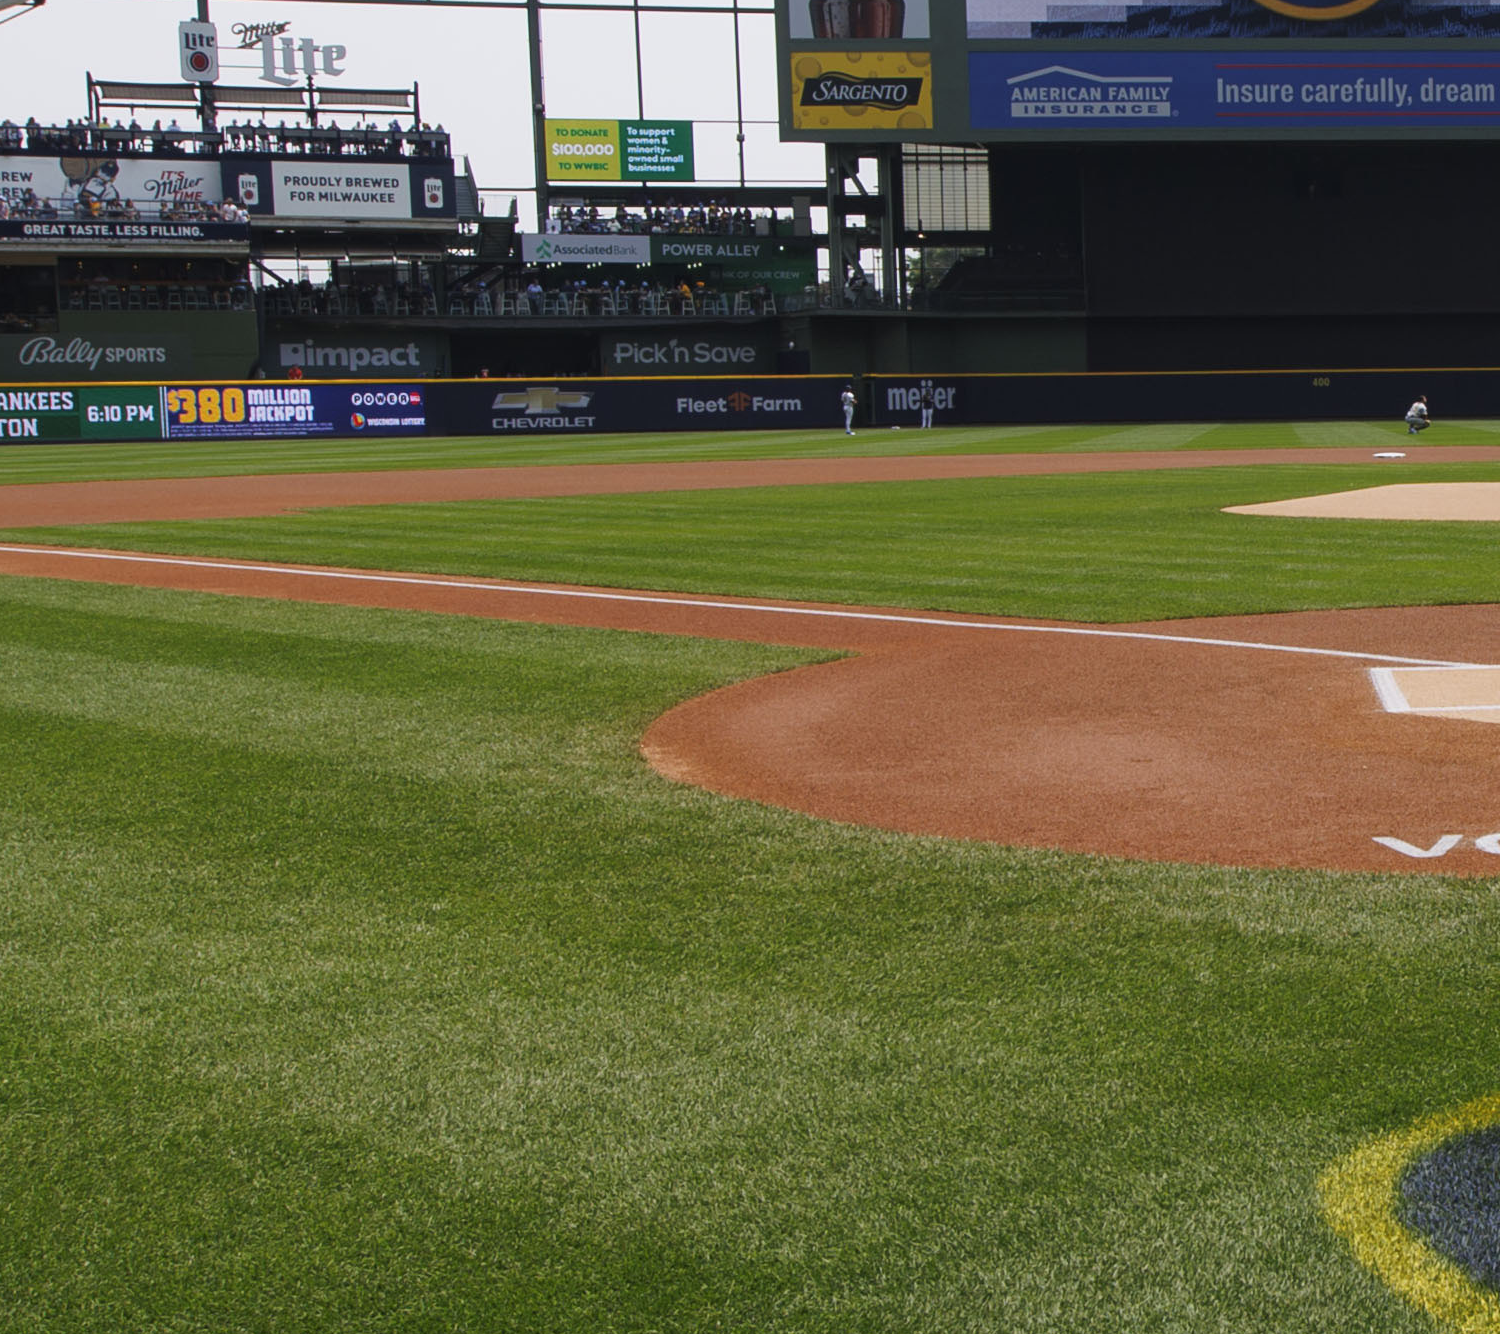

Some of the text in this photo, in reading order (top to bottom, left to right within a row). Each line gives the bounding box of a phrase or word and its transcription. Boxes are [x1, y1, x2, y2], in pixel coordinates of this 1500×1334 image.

[183, 32, 216, 50] Lite
[258, 35, 348, 87] Lite
[812, 80, 908, 102] SARGENTO
[1011, 86, 1171, 102] AMERICAN FAMILY
[1216, 78, 1294, 104] Insure
[1299, 77, 1414, 108] carefully,
[1419, 77, 1496, 104] dream
[1023, 104, 1159, 115] INSURANCE
[556, 127, 609, 138] TO DONATE
[552, 142, 615, 158] $100,000
[558, 161, 570, 172] TO
[160, 170, 185, 181] IT'S
[283, 175, 400, 190] PROUDLY BREWED
[143, 176, 204, 200] Miller
[173, 191, 204, 202] TIME
[290, 191, 396, 203] FOR MILWAUKEE
[23, 223, 204, 238] GREAT TASTE. LESS FILLING.
[661, 243, 761, 258] POWER ALLEY
[19, 336, 167, 371] Bally SPORTS
[306, 339, 420, 371] impact
[693, 342, 756, 364] Save
[1311, 376, 1332, 388] 400
[247, 388, 312, 405] MILLION
[166, 387, 246, 424] $380
[676, 396, 803, 414] Fleet Farm
[86, 404, 155, 423] 6:10 PM
[248, 405, 315, 423] JACKPOT
[491, 416, 597, 429] CHEVROLET
